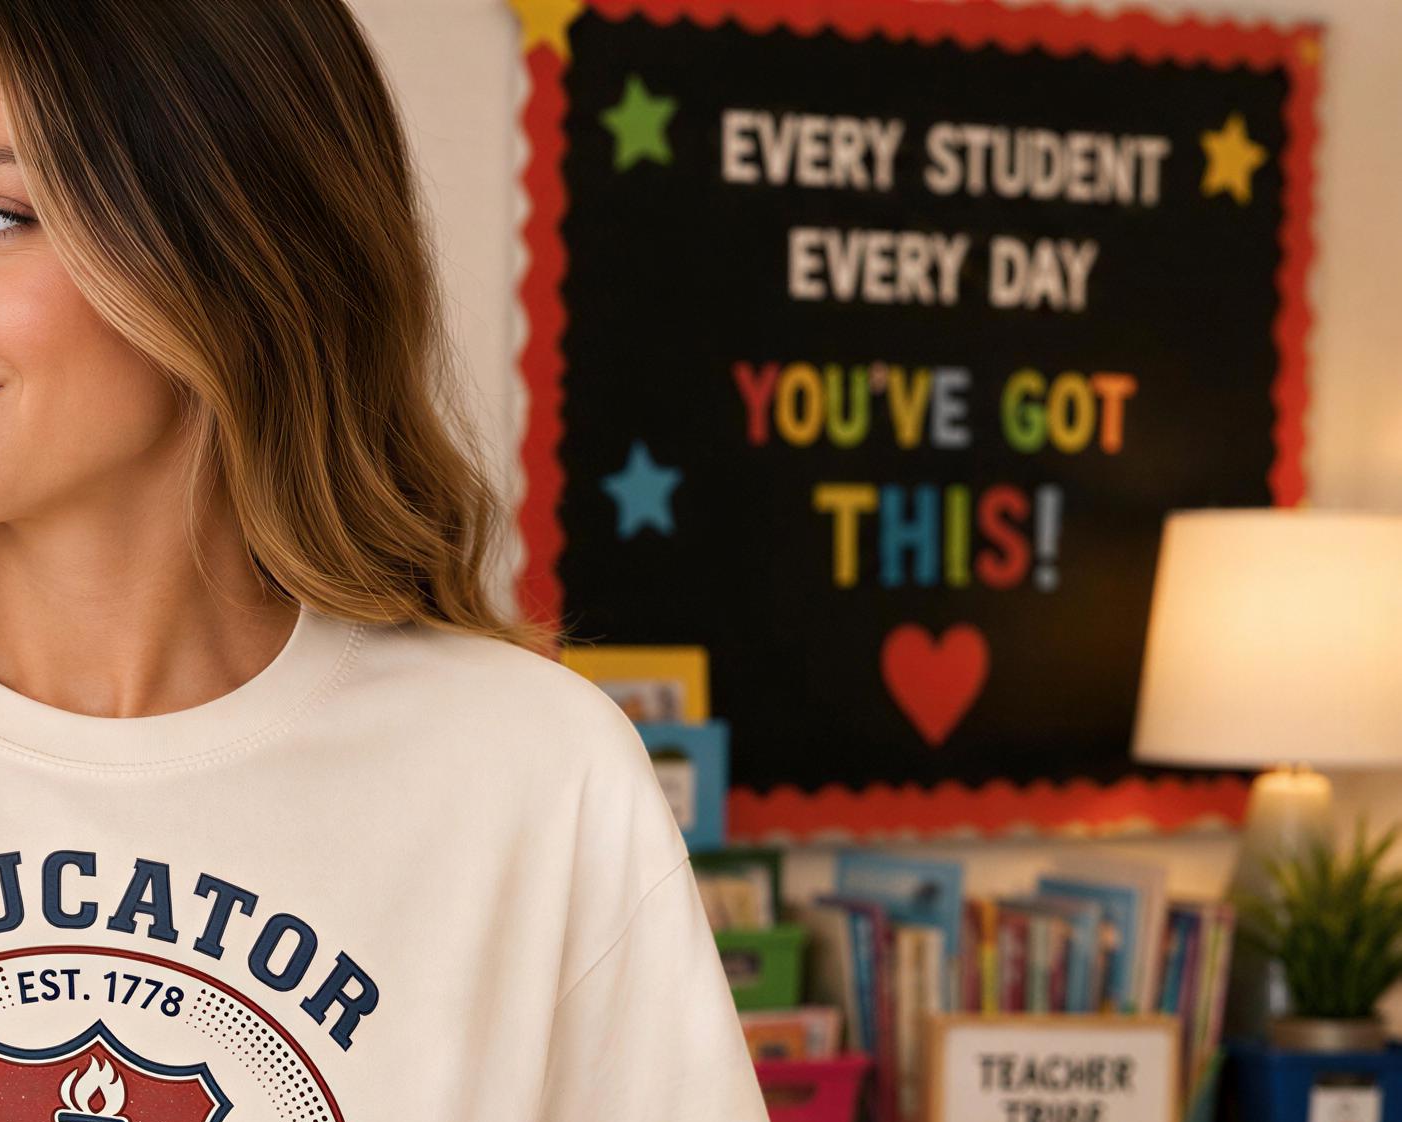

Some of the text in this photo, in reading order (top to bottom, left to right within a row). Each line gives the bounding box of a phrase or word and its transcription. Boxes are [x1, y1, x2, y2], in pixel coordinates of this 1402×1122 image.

[721, 109, 1169, 205] EVERY STUDENT
[788, 227, 1098, 309] EVERY DAY
[733, 361, 1136, 453] YOU'VE GOT
[813, 484, 1062, 590] THIS!
[18, 967, 185, 1018] EST. 1778
[978, 1053, 1133, 1092] TEACHER
